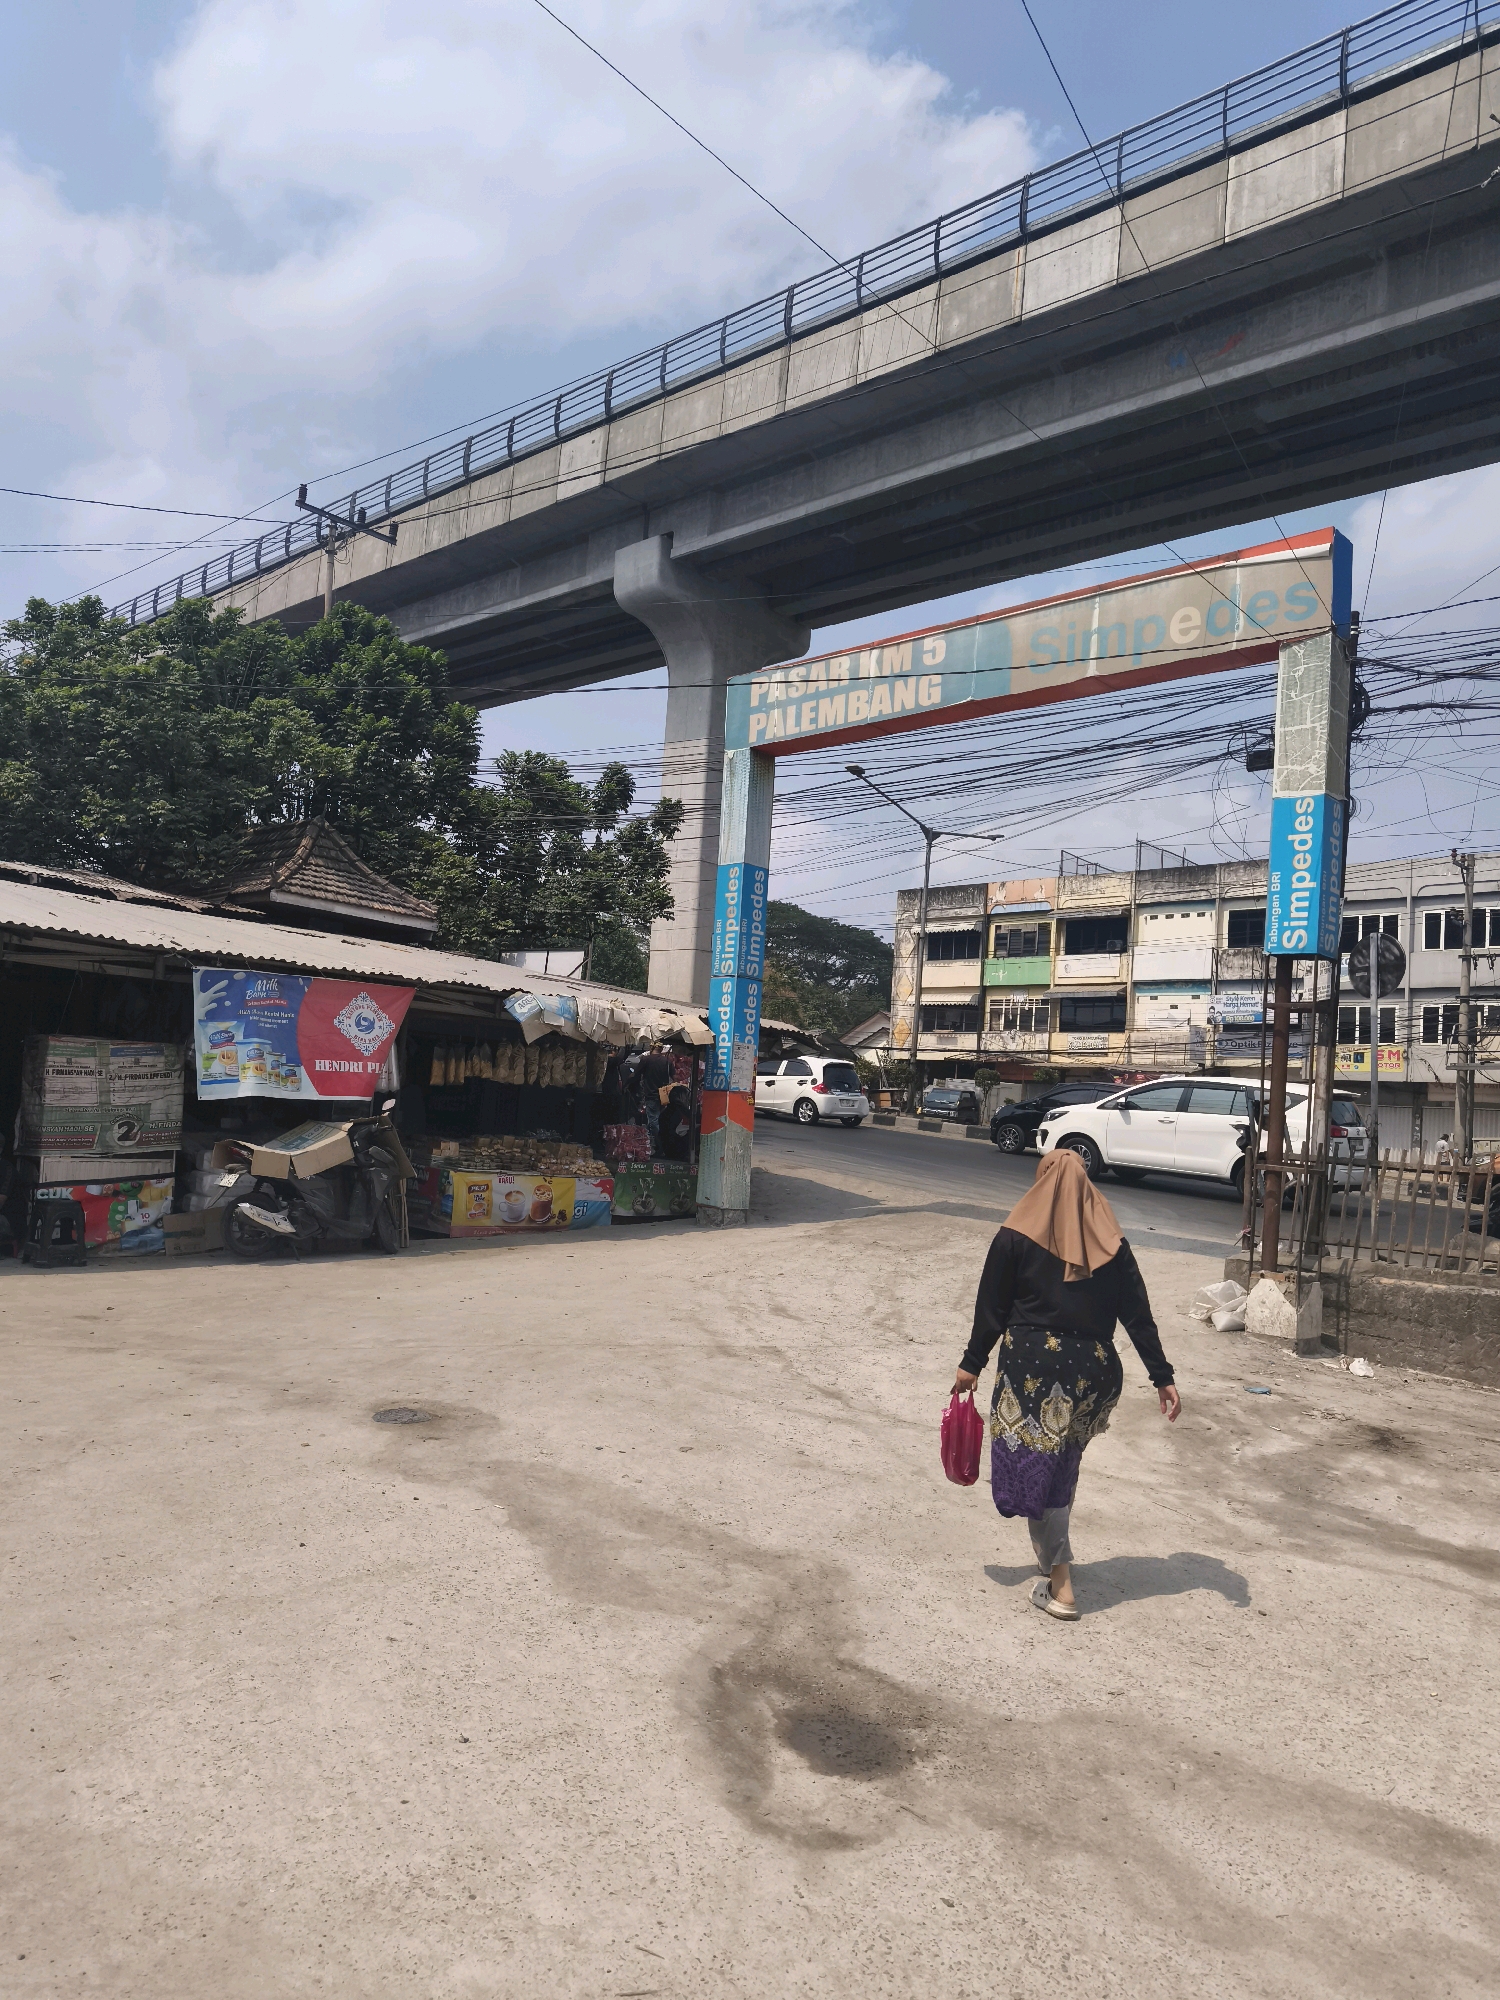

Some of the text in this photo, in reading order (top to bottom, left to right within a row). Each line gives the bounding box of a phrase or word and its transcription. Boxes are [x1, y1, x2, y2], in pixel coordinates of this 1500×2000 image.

[1027, 580, 1319, 674] Simpedes
[750, 634, 947, 708] PASAR KM 5
[749, 674, 942, 744] PALEMBANG
[1282, 797, 1317, 950] Simpedes
[1324, 801, 1342, 954] Simpedes
[720, 866, 740, 974] Simpedes
[746, 869, 766, 978] Simpedes
[1267, 871, 1282, 950] Tabungan BRI
[254, 978, 279, 992] Milk
[713, 935, 722, 975] Tabungan
[739, 935, 747, 974] Tabungan
[712, 980, 733, 1090] Simpedes
[743, 983, 758, 1050] pedes
[1230, 1040, 1257, 1049] Optik
[315, 1059, 363, 1073] HENDRI
[705, 1049, 714, 1087] Tabungan
[117, 1120, 136, 1142] 2
